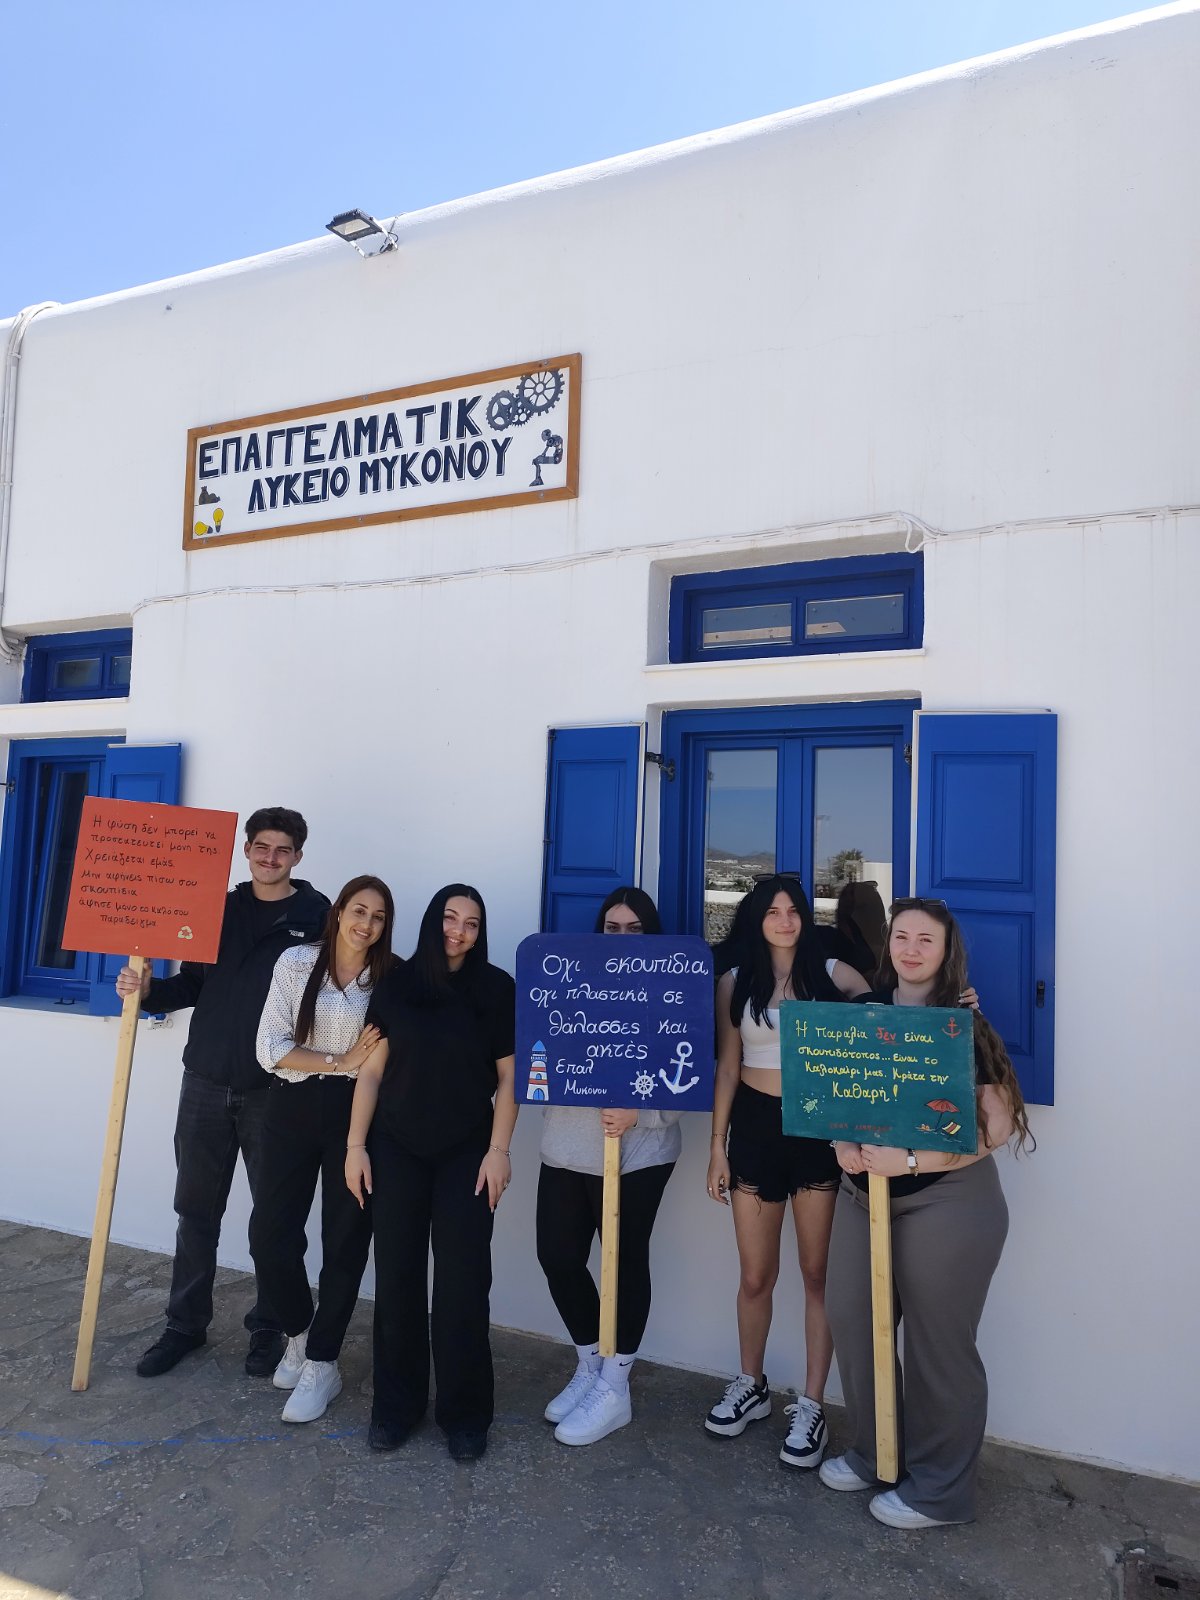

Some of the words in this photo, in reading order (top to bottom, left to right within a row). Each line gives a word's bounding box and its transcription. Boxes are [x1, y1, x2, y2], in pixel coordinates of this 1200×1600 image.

[247, 465, 351, 514] ΛΥΚΕΙΟ
[358, 435, 513, 494] ΜΥΚΟΝΟΥ
[93, 815, 102, 828] Η
[141, 823, 158, 834] δεν
[565, 983, 649, 1002] πλαστικά
[663, 990, 685, 1005] σε
[548, 1010, 641, 1036] θάλασσες
[656, 1019, 688, 1034] και
[795, 1019, 808, 1038] Η
[876, 1027, 897, 1041] δεν
[904, 1032, 935, 1043] είναι
[586, 1040, 649, 1060] ακτές
[924, 1057, 939, 1065] το
[930, 1074, 950, 1085] την
